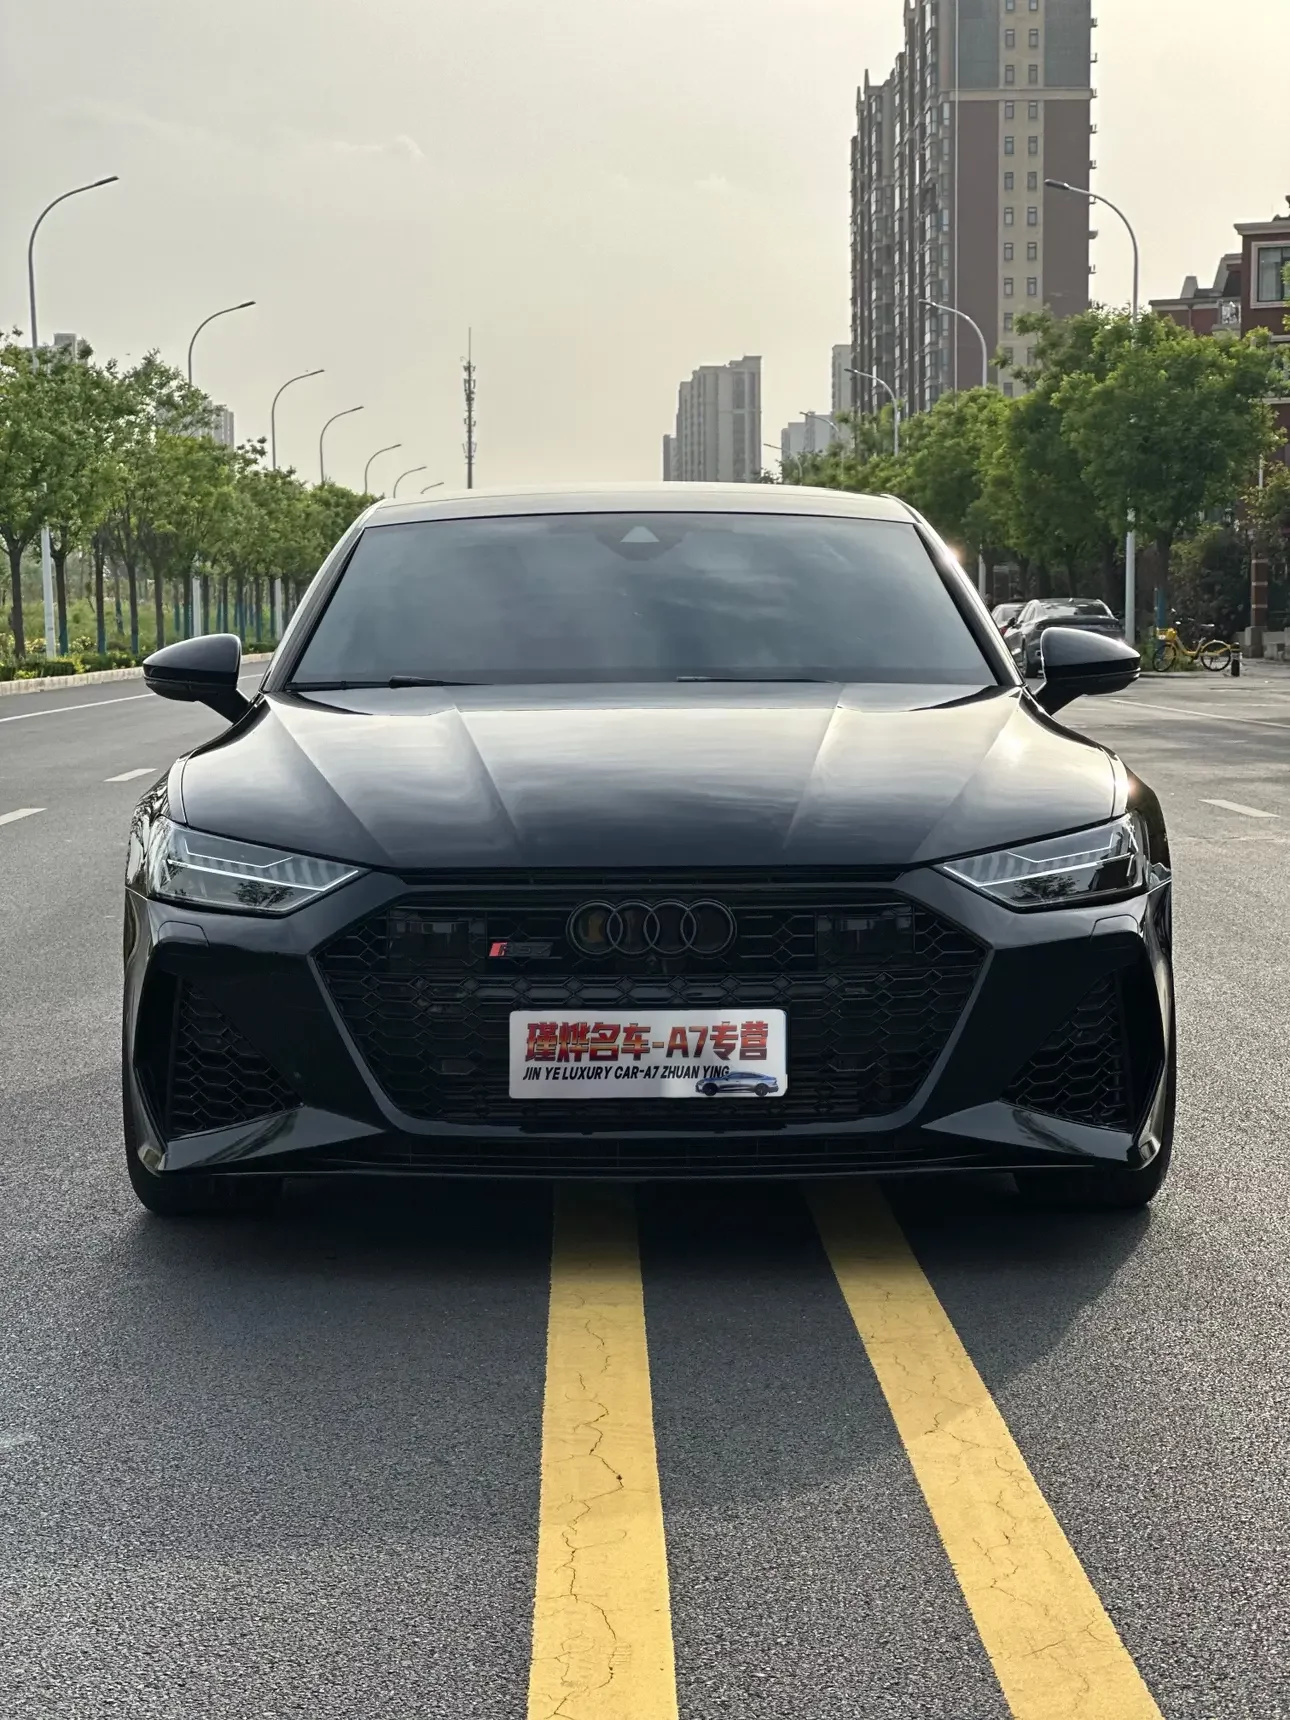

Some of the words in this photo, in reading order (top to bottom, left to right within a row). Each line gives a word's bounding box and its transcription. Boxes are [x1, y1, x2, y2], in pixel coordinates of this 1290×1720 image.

[525, 1021, 769, 1062] 瑾烨名车-A7专营
[523, 1067, 541, 1080] JIN
[545, 1067, 562, 1080] YE
[562, 1066, 613, 1080] LUXURY
[614, 1066, 660, 1079] CAR-A7
[660, 1066, 700, 1079] ZHUAN
[702, 1066, 730, 1079] YING
